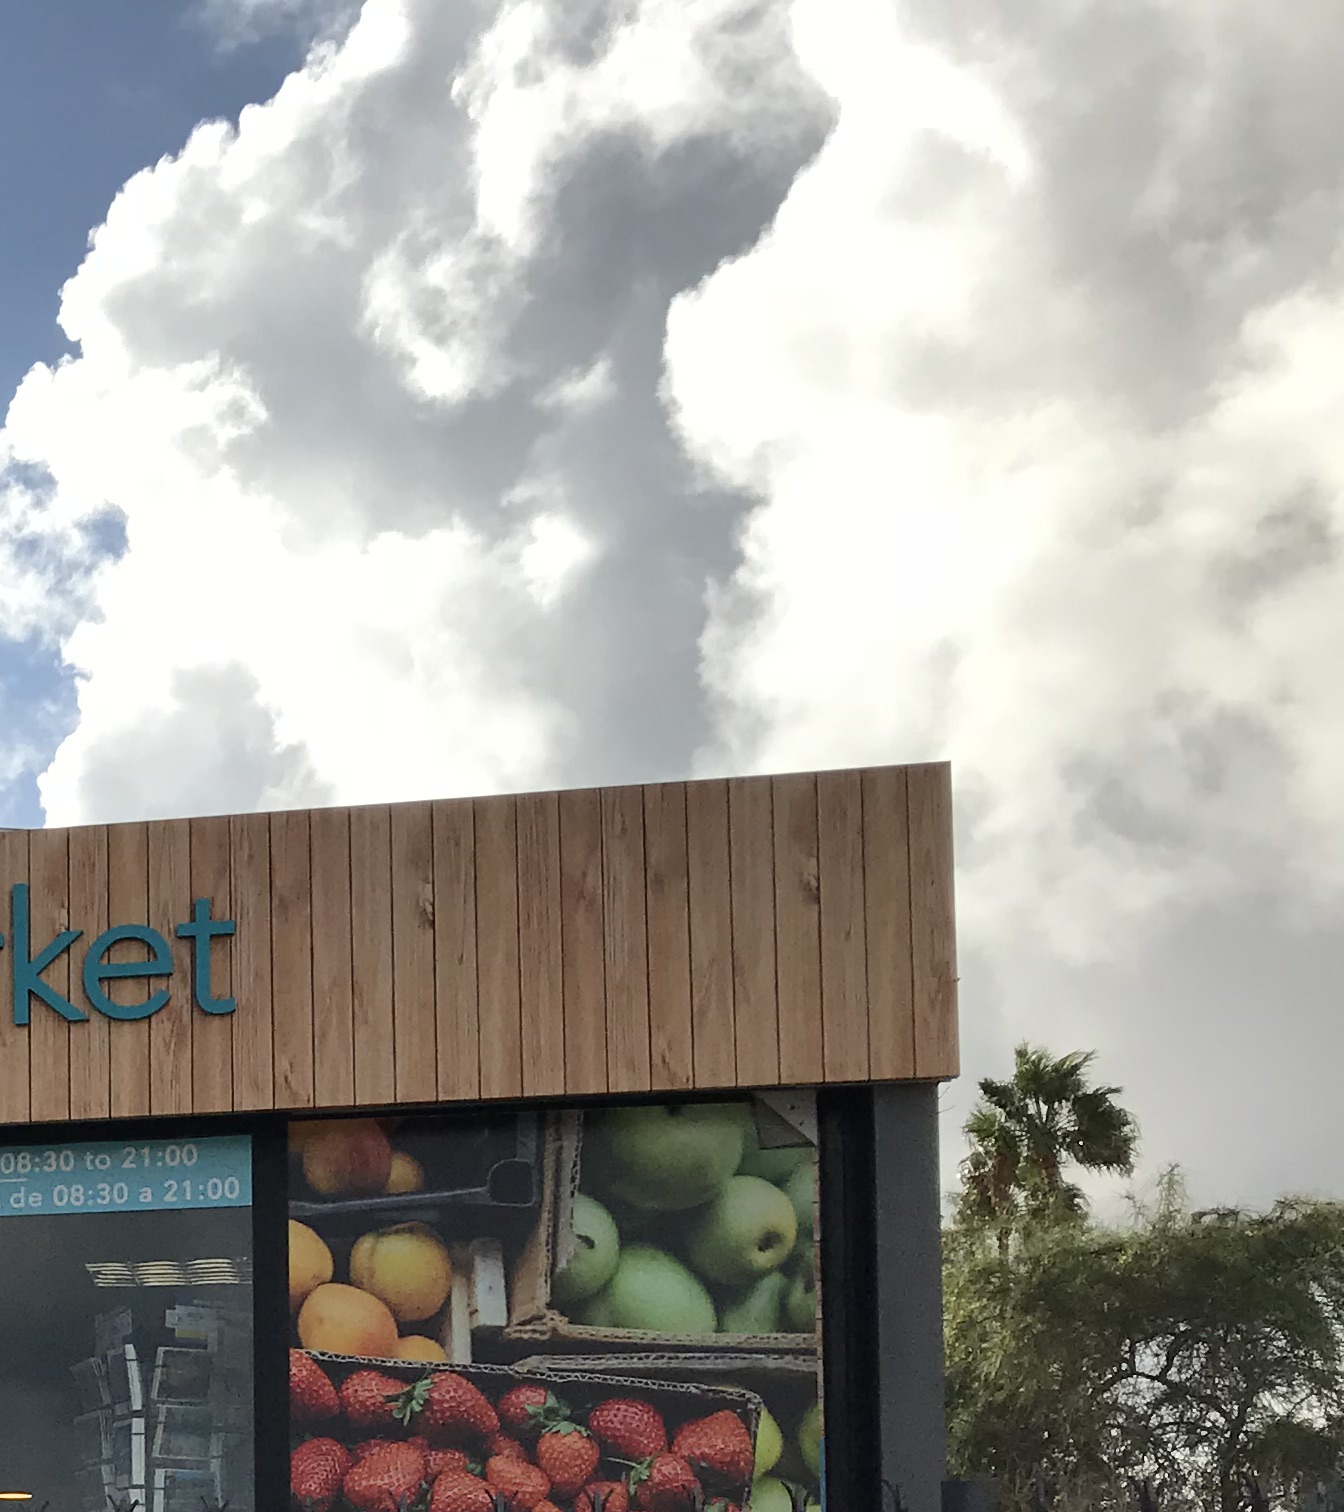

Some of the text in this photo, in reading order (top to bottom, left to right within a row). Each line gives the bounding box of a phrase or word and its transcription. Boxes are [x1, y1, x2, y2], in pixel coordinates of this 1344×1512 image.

[0, 1149, 76, 1174] 08:30
[85, 1150, 111, 1171] to
[121, 1143, 199, 1169] 21:00
[9, 1186, 43, 1209] de
[52, 1182, 129, 1207] 08:30
[138, 1188, 154, 1203] a
[163, 1176, 241, 1202] 21:00
